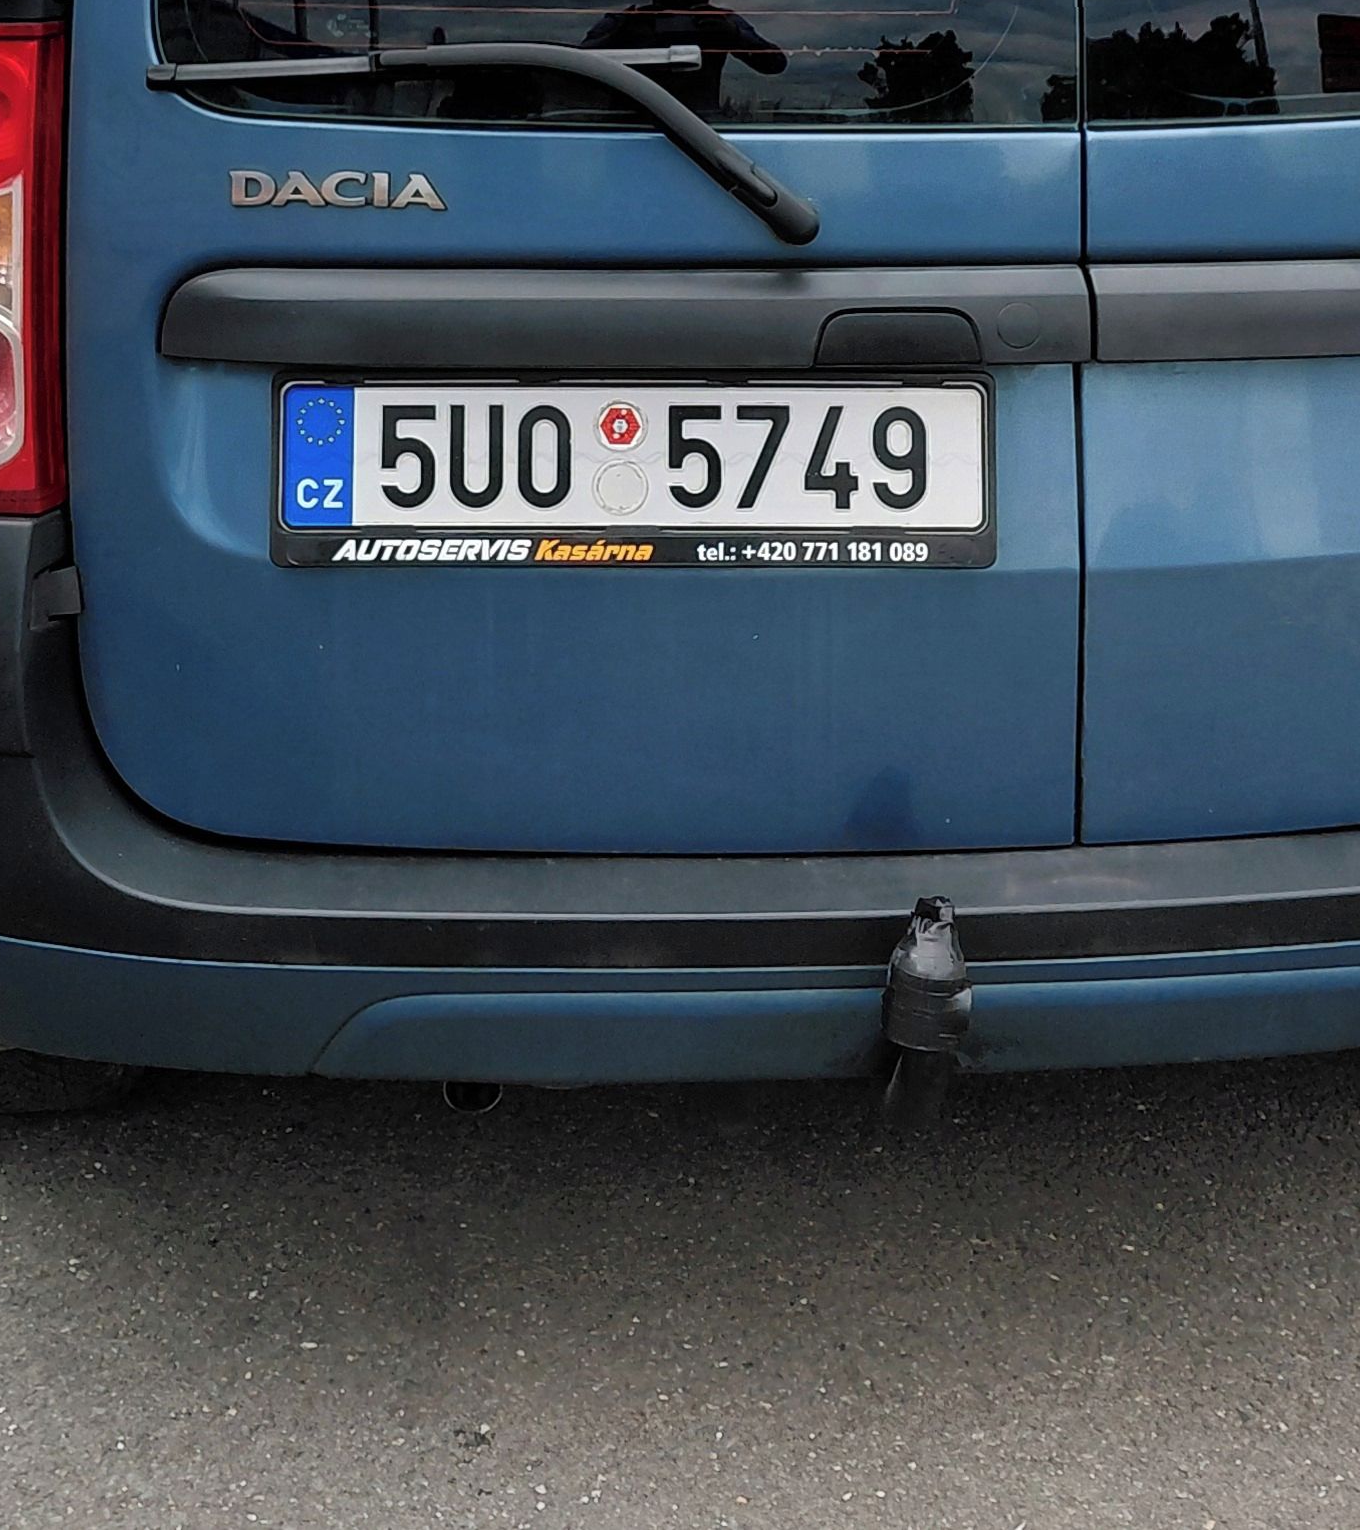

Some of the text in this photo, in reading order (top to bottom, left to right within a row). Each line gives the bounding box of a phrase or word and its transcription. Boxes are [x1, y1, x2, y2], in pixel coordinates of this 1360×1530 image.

[229, 170, 447, 210] DACIA
[667, 404, 928, 510] 5749
[295, 478, 344, 509] CZ
[332, 539, 930, 563] AUTOSERVIS Kasárna tel.: +420 771 181 089
